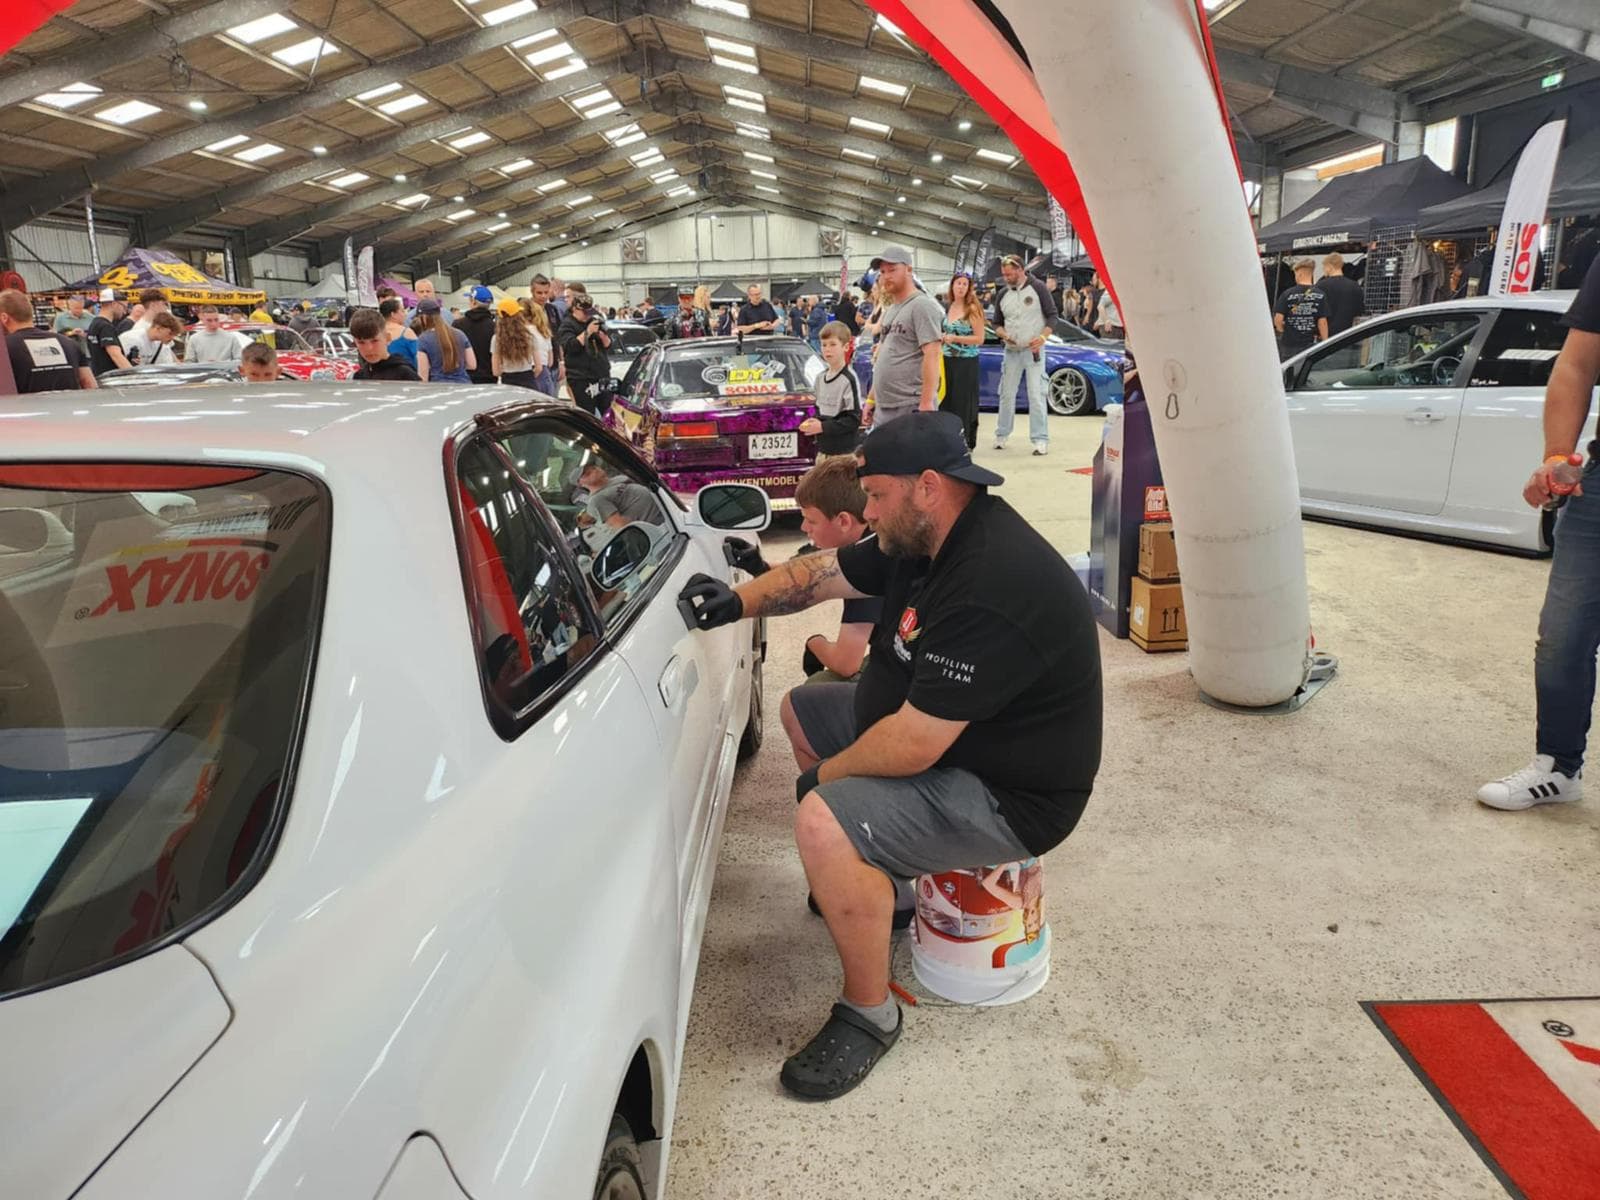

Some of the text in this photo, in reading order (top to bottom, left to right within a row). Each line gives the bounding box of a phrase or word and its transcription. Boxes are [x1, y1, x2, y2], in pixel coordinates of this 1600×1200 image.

[1503, 255, 1511, 267] IN
[724, 384, 779, 395] SONAX
[751, 434, 793, 450] A 23522
[942, 668, 972, 684] TEAM
